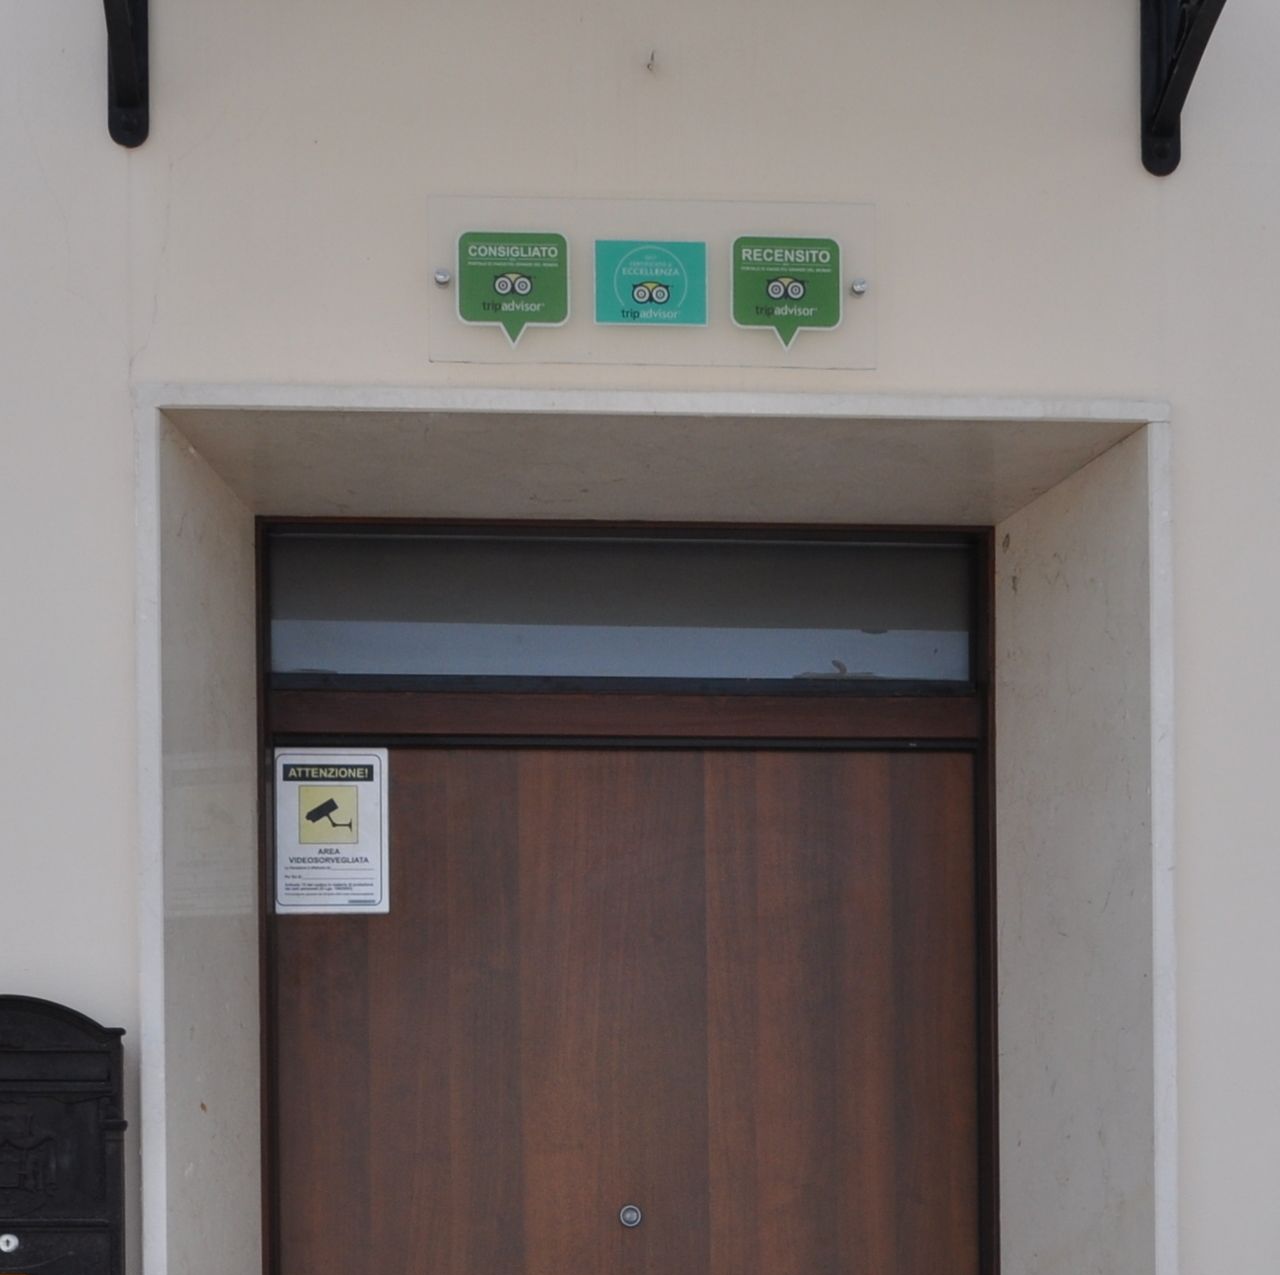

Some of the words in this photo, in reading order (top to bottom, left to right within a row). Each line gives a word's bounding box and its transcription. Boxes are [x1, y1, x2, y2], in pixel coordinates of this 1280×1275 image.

[467, 245, 559, 258] CONSIGLIATO
[741, 248, 831, 263] RECENSITO
[622, 267, 680, 276] ECCELLENZA
[482, 300, 544, 313] tripadvisor
[755, 304, 816, 318] tripadvisor
[621, 308, 678, 320] tripadvisor
[288, 767, 369, 779] ATTENZIONE!
[288, 856, 369, 864] VIDEOSORVEGLIATA
